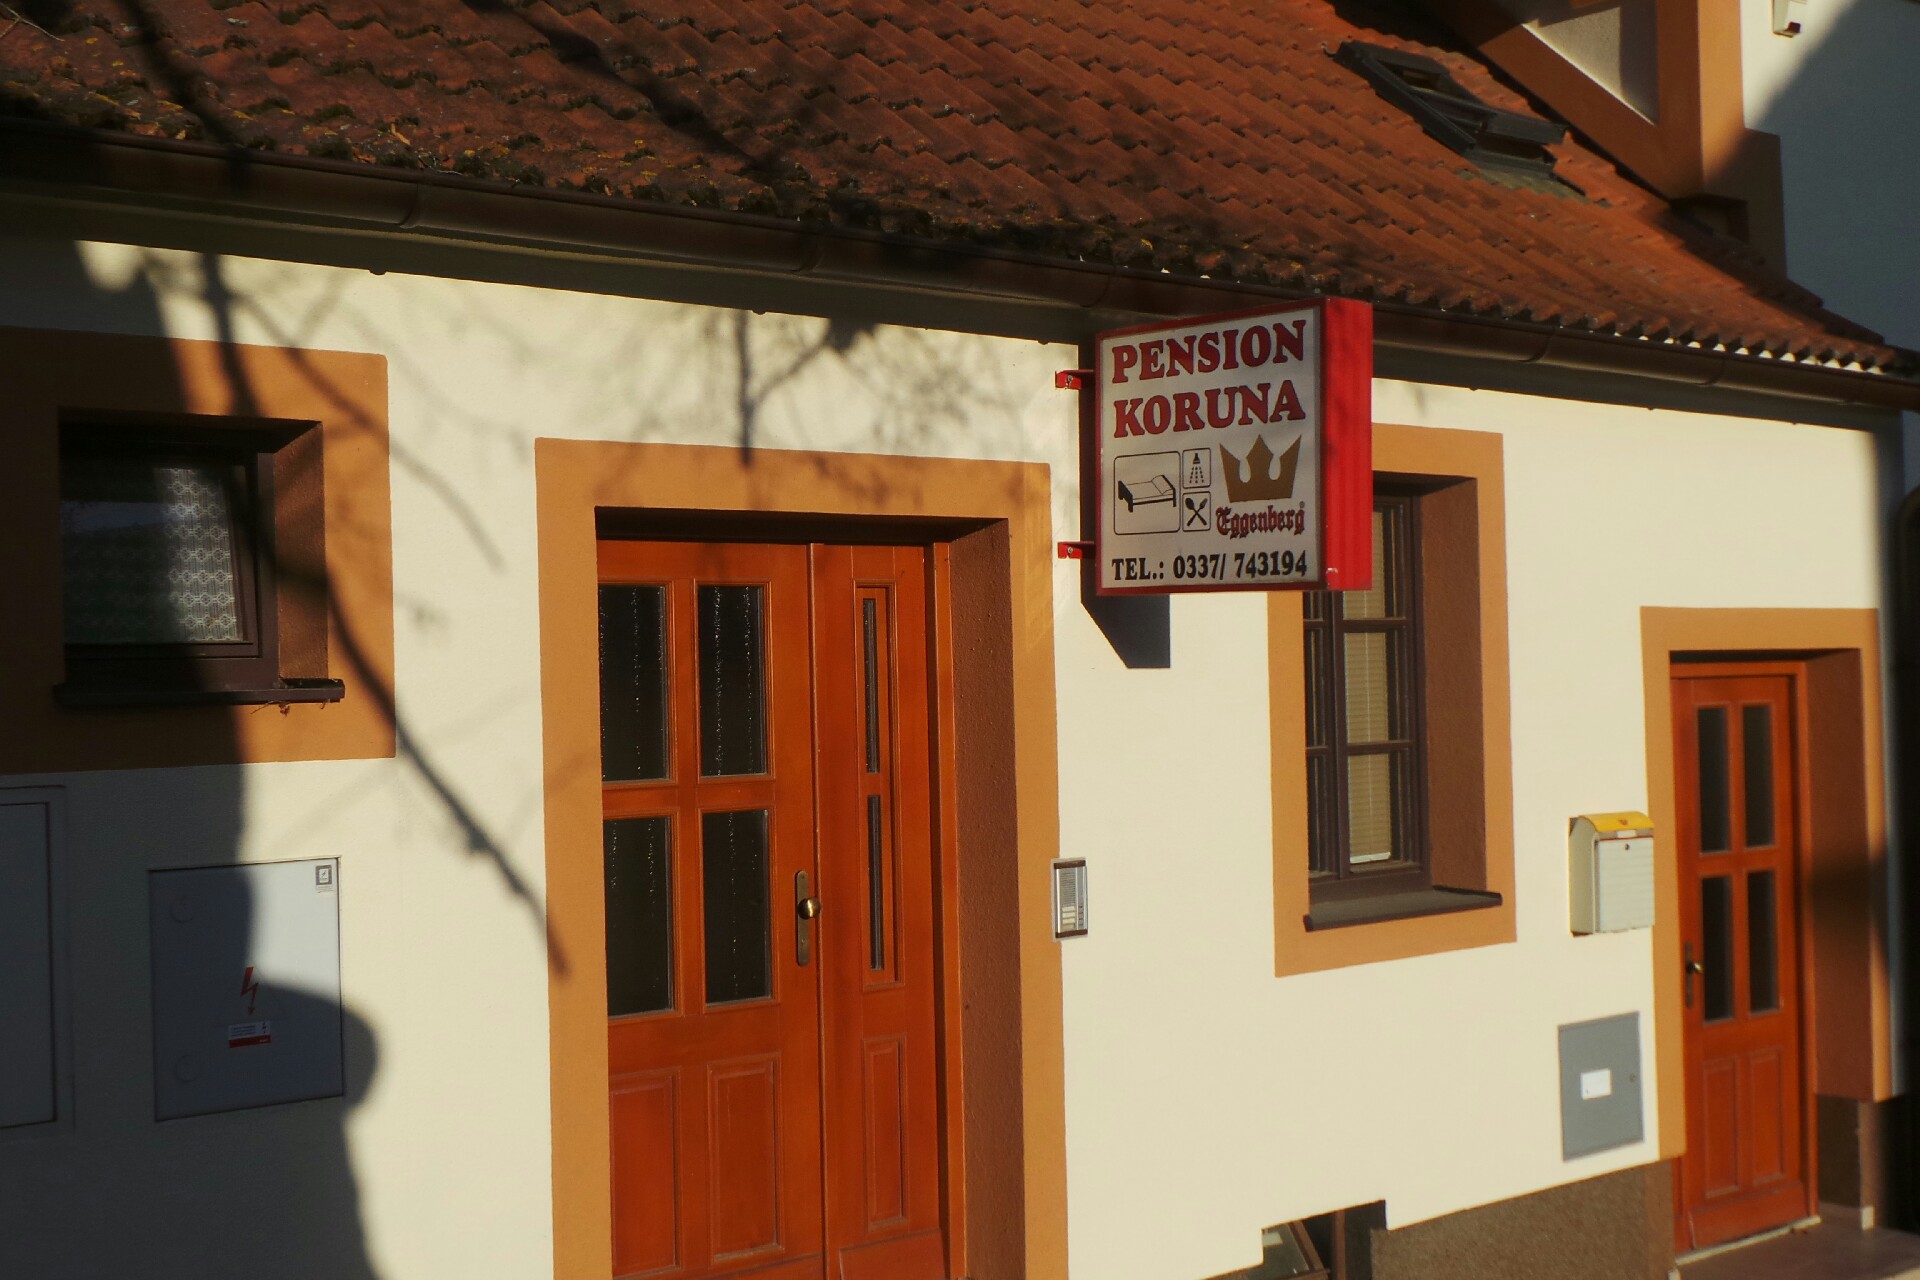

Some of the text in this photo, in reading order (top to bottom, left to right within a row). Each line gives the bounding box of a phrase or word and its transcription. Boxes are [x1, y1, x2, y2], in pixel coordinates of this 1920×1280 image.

[1112, 319, 1306, 383] PENSION
[1113, 379, 1306, 438] KORUNA
[1216, 504, 1305, 539] Eggenberg
[1112, 550, 1307, 580] TEL.: 0337/ 743194
